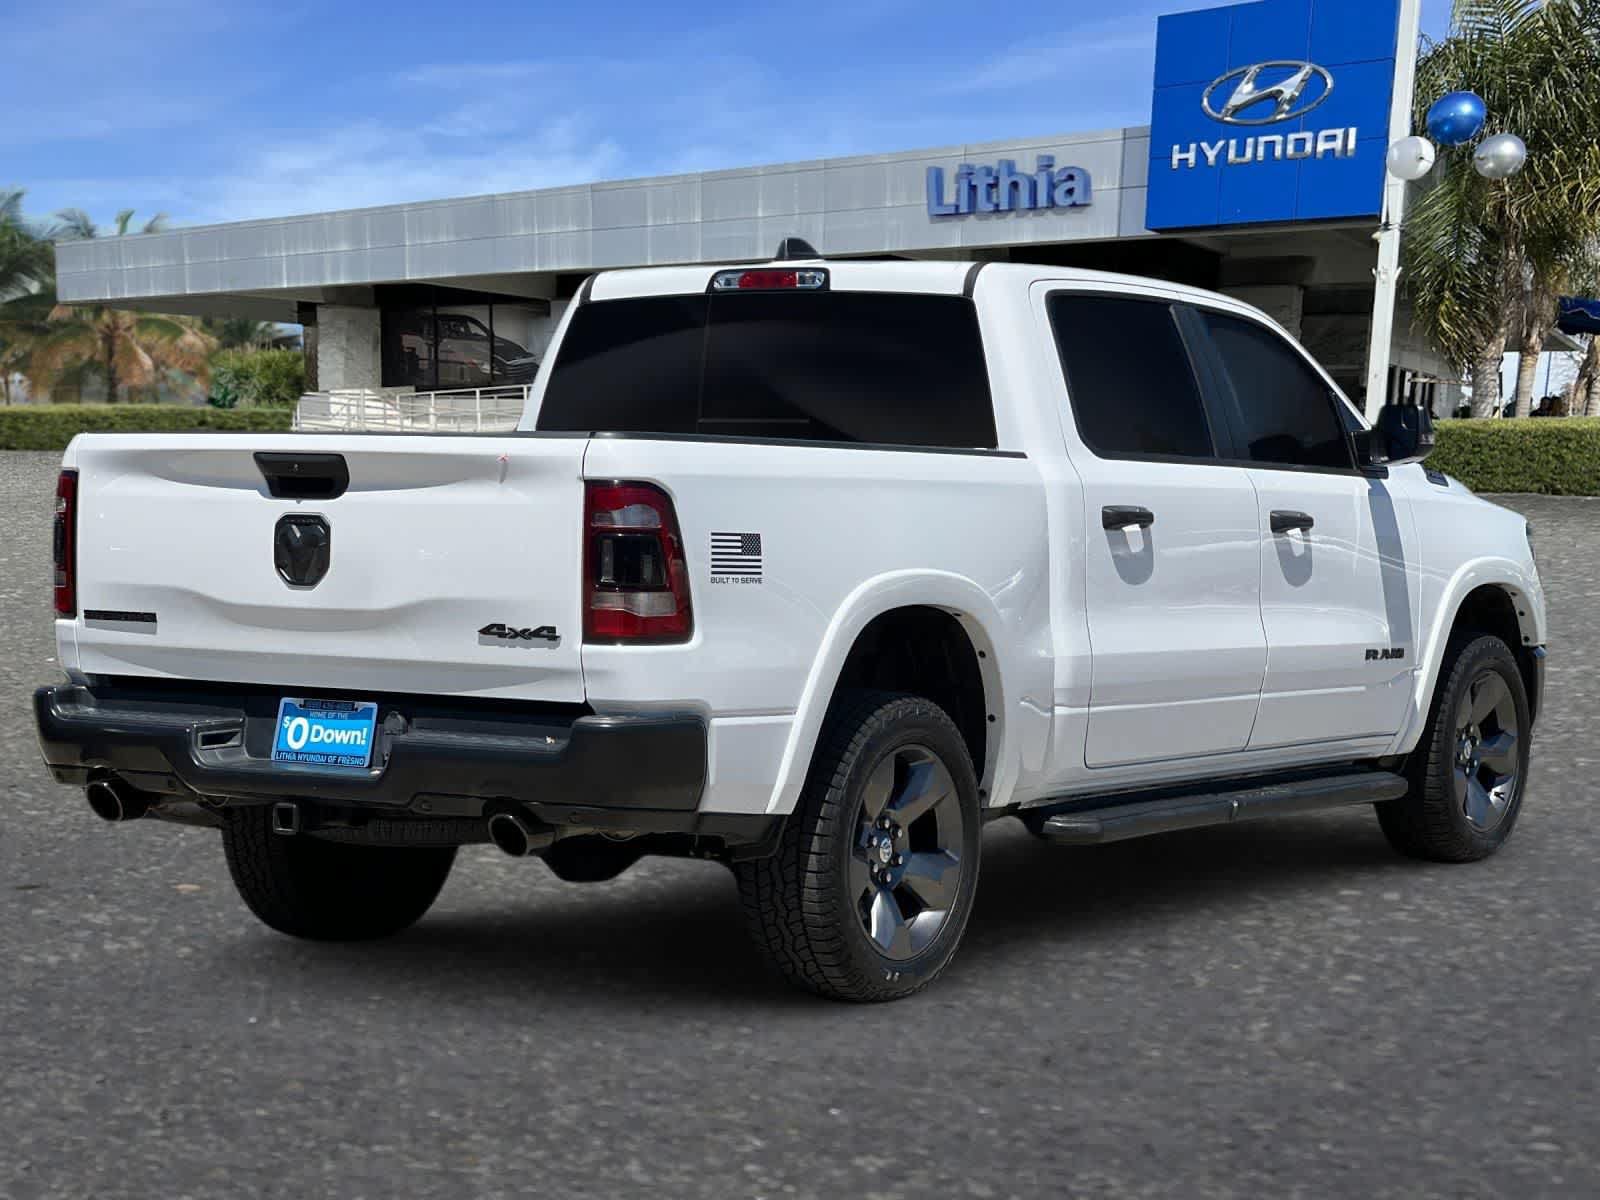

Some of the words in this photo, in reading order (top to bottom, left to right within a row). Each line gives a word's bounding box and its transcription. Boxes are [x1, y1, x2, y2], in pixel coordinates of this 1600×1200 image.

[1171, 127, 1357, 169] HYUNDAI
[927, 155, 1092, 216] Lithia
[1365, 648, 1404, 660] RAM
[283, 716, 309, 750] $0
[310, 725, 368, 745] Down!
[276, 752, 297, 761] LITHIA
[297, 753, 327, 763] HYUNDAI
[327, 755, 337, 763] OF
[338, 756, 365, 766] FRESNO
